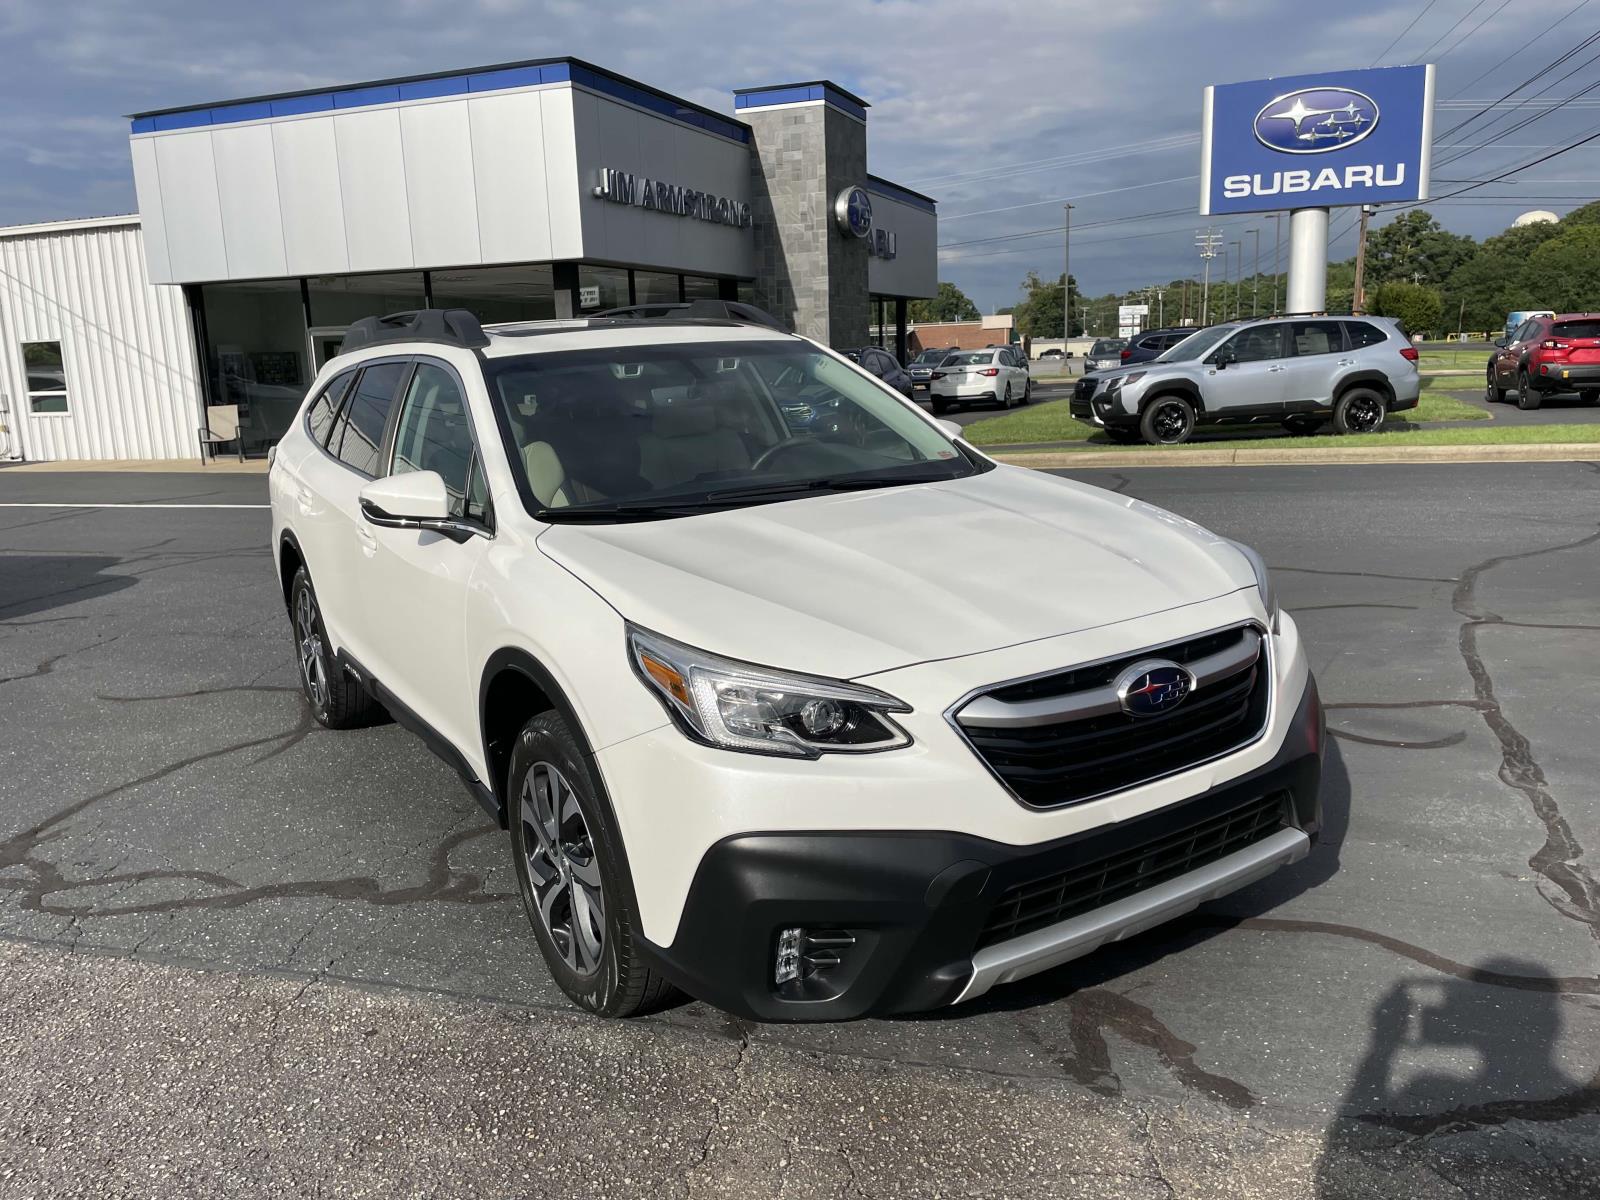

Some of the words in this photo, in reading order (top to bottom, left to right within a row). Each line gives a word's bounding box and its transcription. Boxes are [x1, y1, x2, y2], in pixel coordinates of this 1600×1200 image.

[593, 168, 635, 205] JIM
[641, 178, 752, 227] ARMSTRONG
[1223, 163, 1405, 198] SUBARU
[867, 228, 897, 259] ARU
